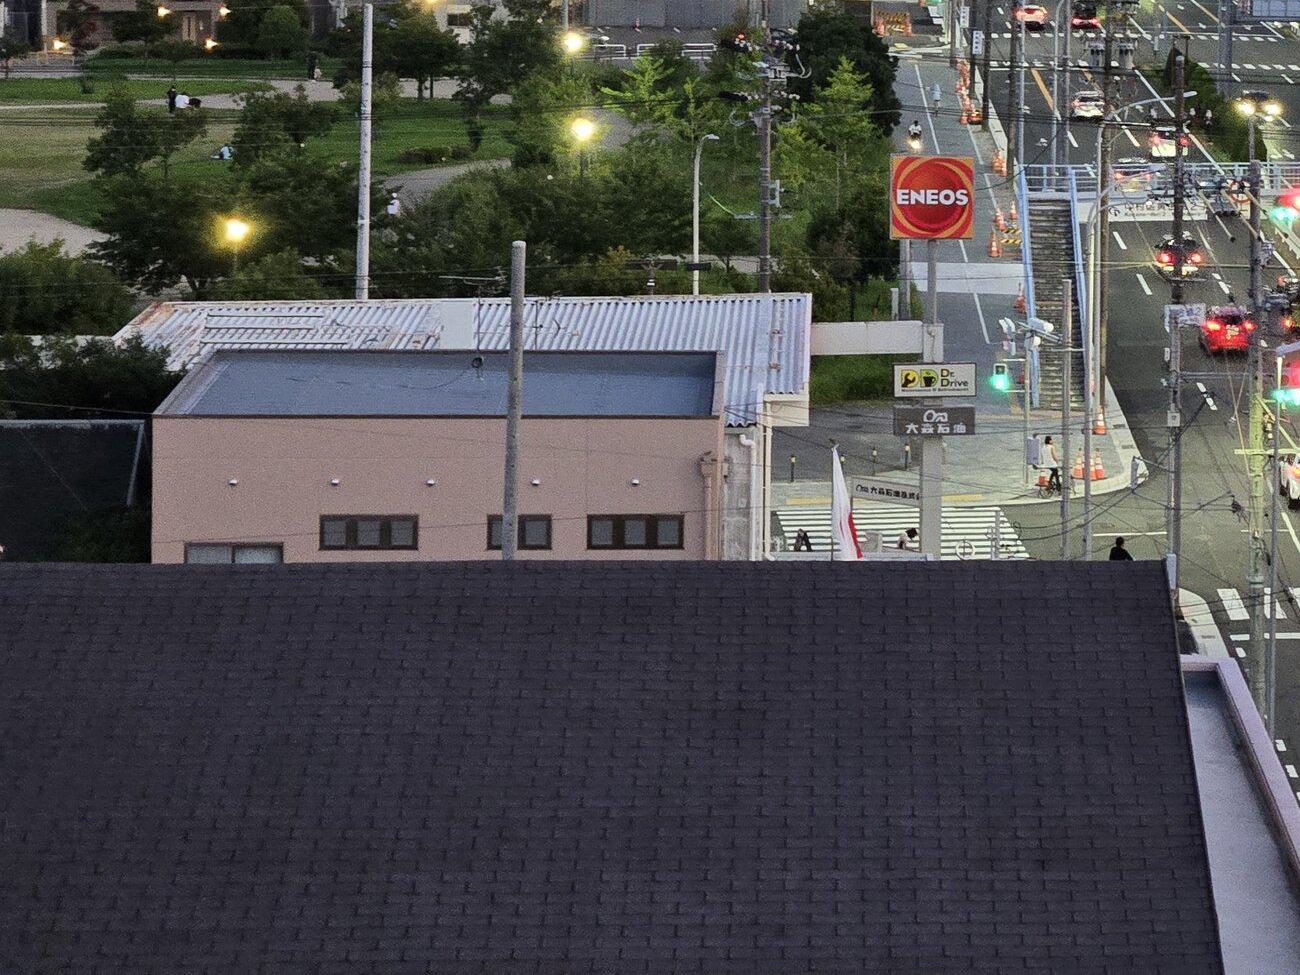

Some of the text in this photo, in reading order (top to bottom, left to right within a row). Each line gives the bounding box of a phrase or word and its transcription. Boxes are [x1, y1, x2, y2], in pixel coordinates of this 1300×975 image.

[896, 189, 969, 205] ENEOS
[940, 368, 955, 377] Dr.
[940, 378, 969, 387] Drive
